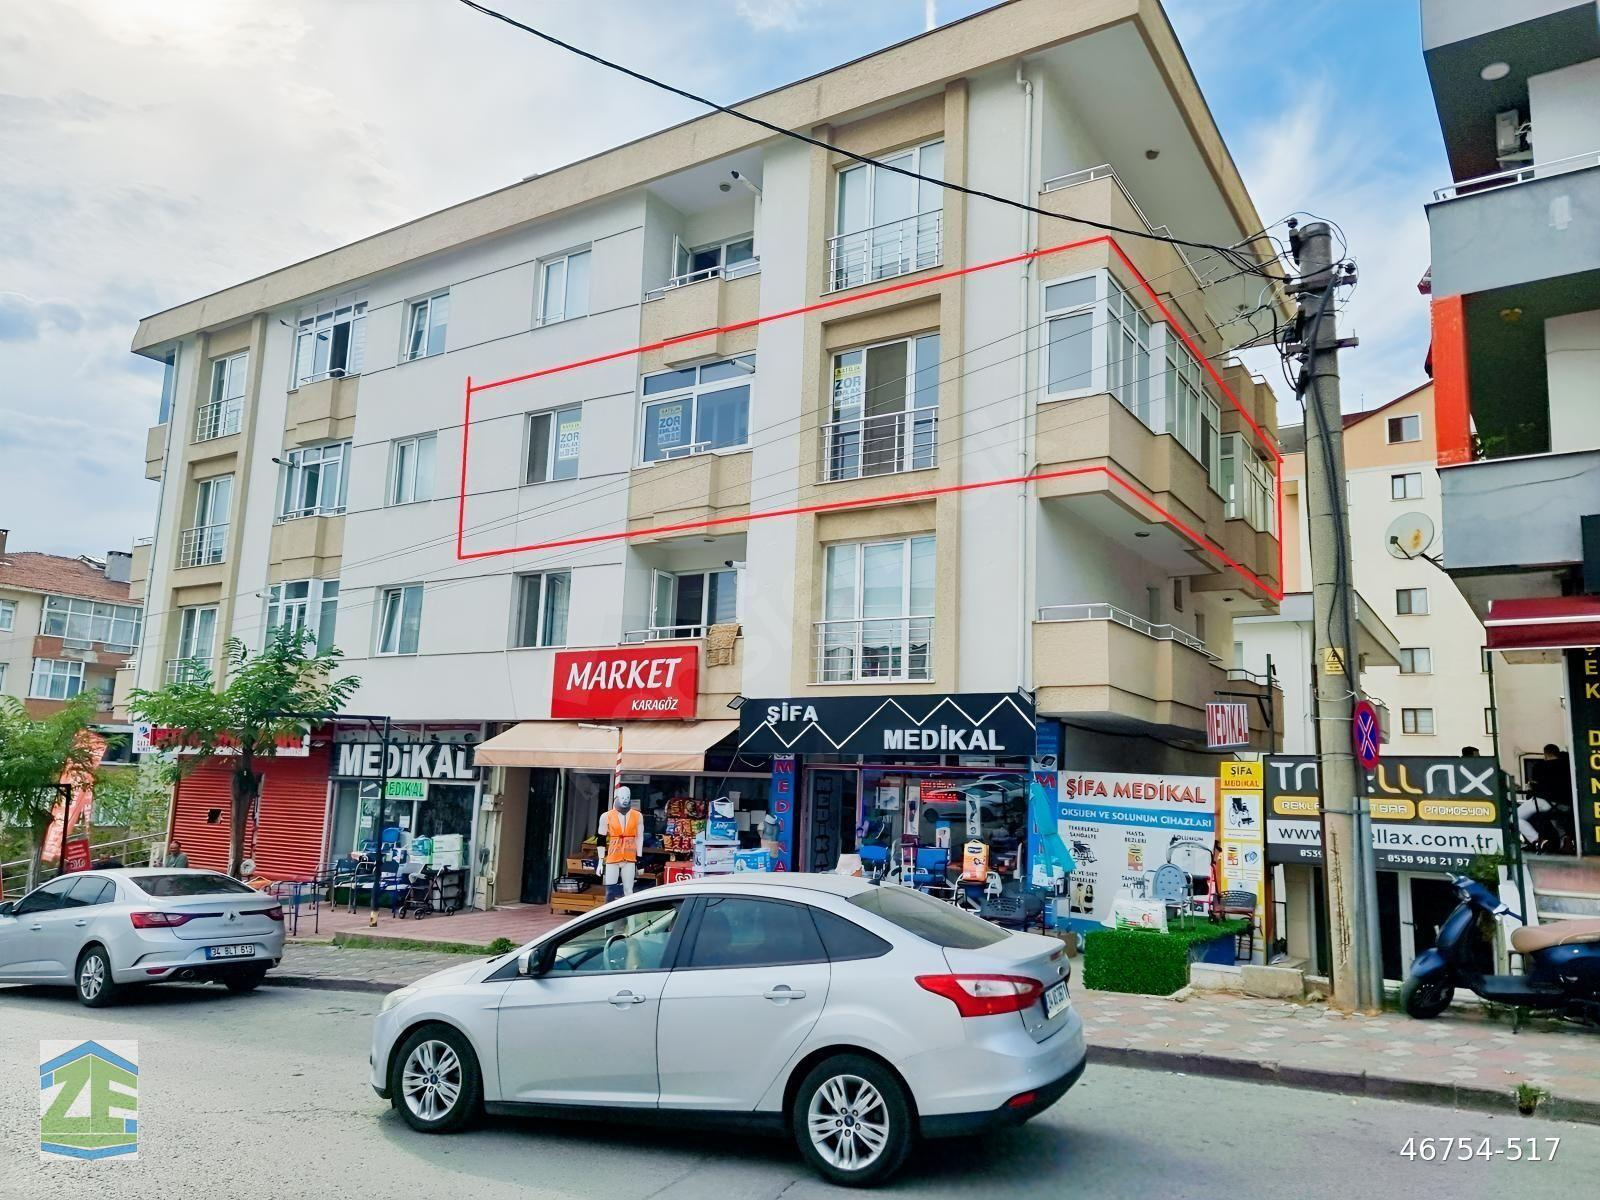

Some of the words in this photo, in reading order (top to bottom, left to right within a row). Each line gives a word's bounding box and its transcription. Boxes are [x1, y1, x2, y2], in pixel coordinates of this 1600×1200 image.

[659, 416, 680, 428] ZOR
[566, 657, 682, 691] MARKET
[631, 697, 679, 711] KARAGÖZ
[766, 702, 819, 726] ŞİFA
[884, 725, 1006, 751] MEDİKAL
[1066, 777, 1108, 799] ŞİFA
[1113, 779, 1207, 804] MEDİKAL
[1099, 811, 1110, 820] VE
[1112, 813, 1158, 824] SOLUNUM
[1439, 857, 1452, 867] 21
[1456, 858, 1471, 868] 97
[211, 947, 221, 956] 34
